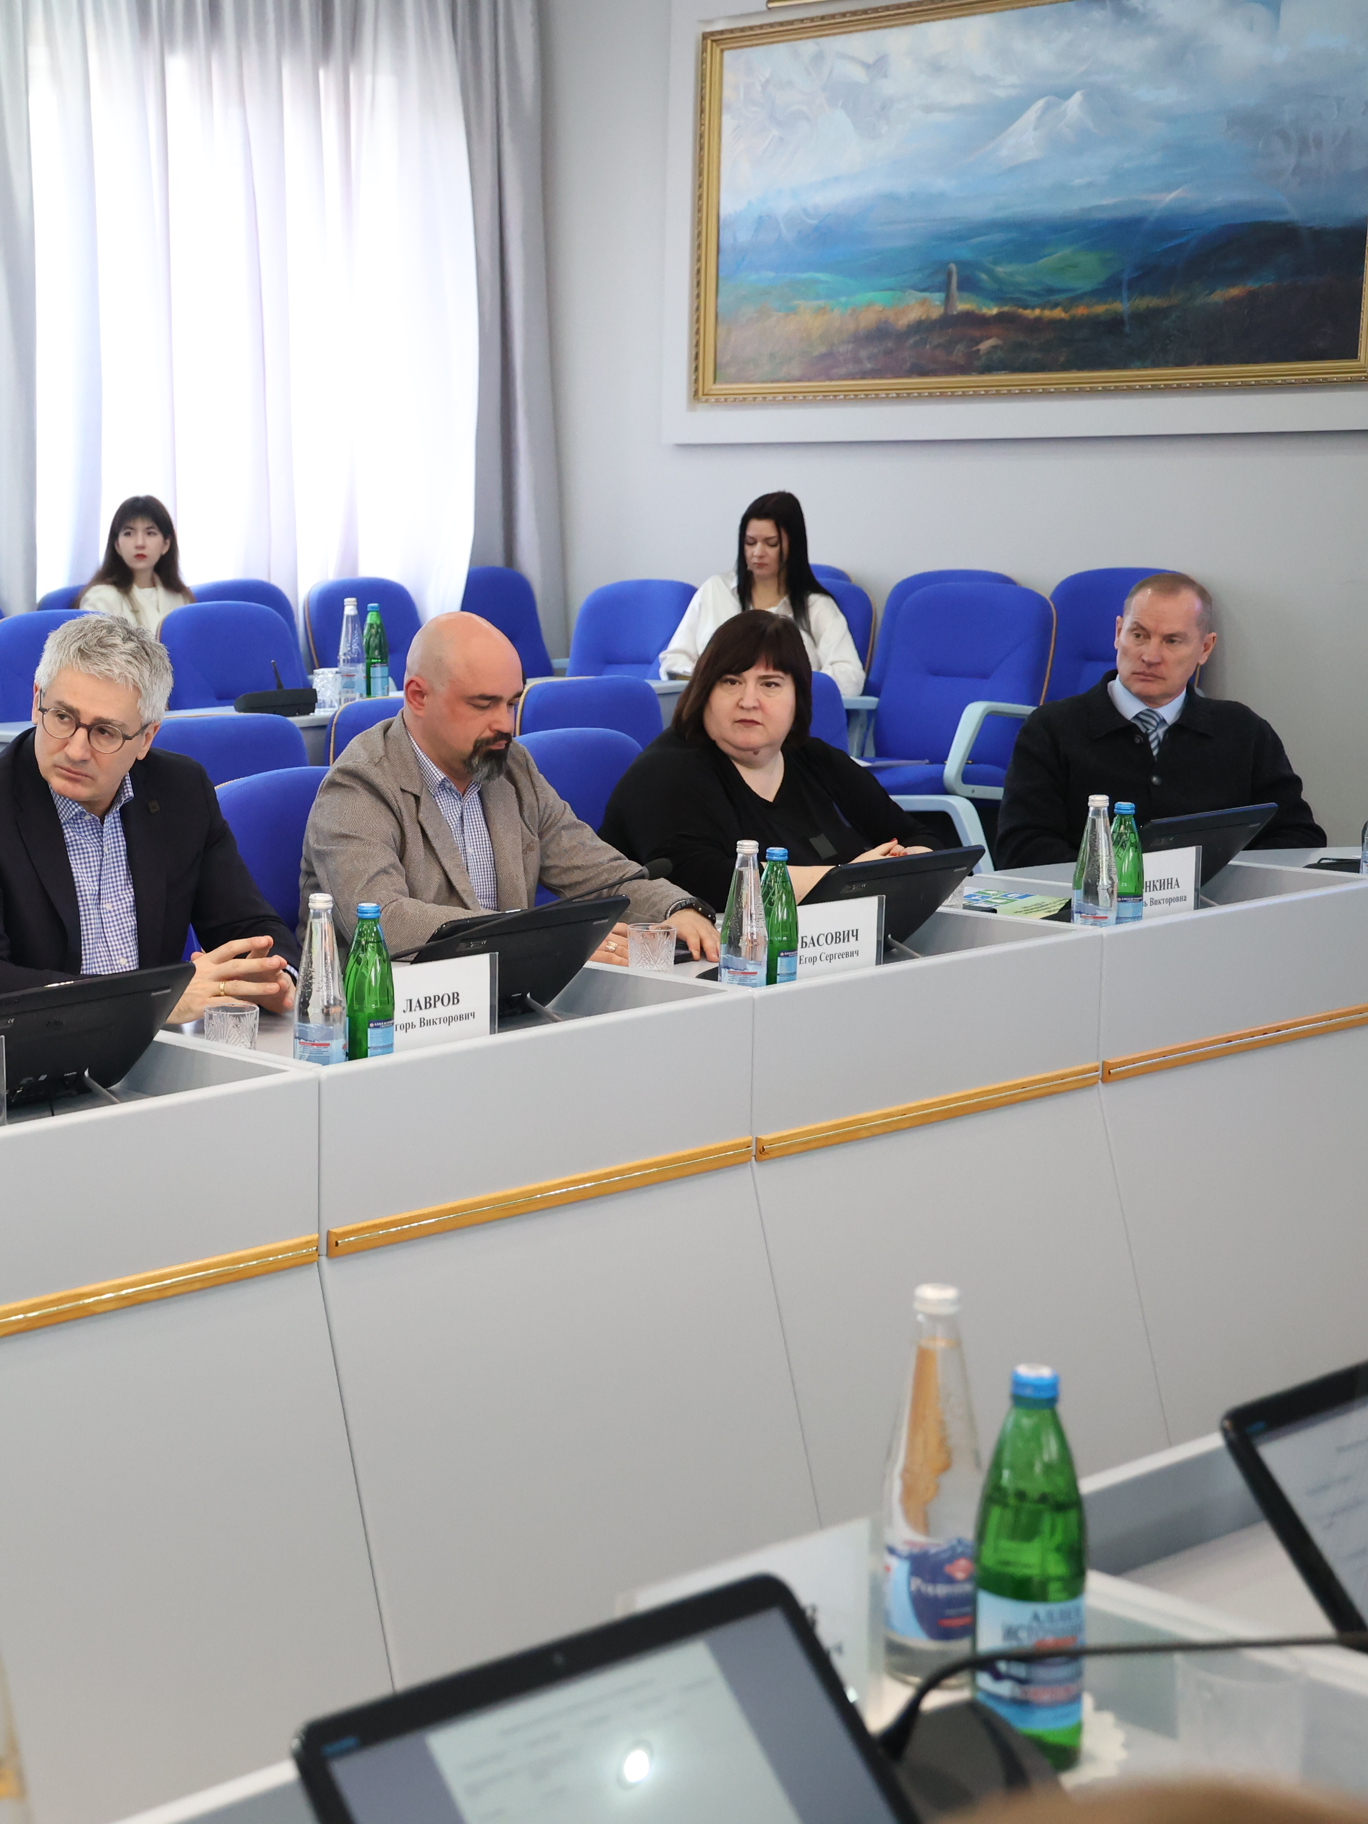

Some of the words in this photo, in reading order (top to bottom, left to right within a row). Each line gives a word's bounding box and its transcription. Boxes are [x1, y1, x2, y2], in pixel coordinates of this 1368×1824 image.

[1144, 877, 1180, 893] НКИНА
[1149, 895, 1187, 906] Викторовна
[800, 928, 859, 949] БАСОВИЧ
[798, 954, 818, 966] Егор
[819, 950, 859, 963] Сергеевич
[402, 991, 460, 1013] ЛАВРОВ
[394, 1021, 416, 1033] горь
[419, 1012, 476, 1028] Викторович
